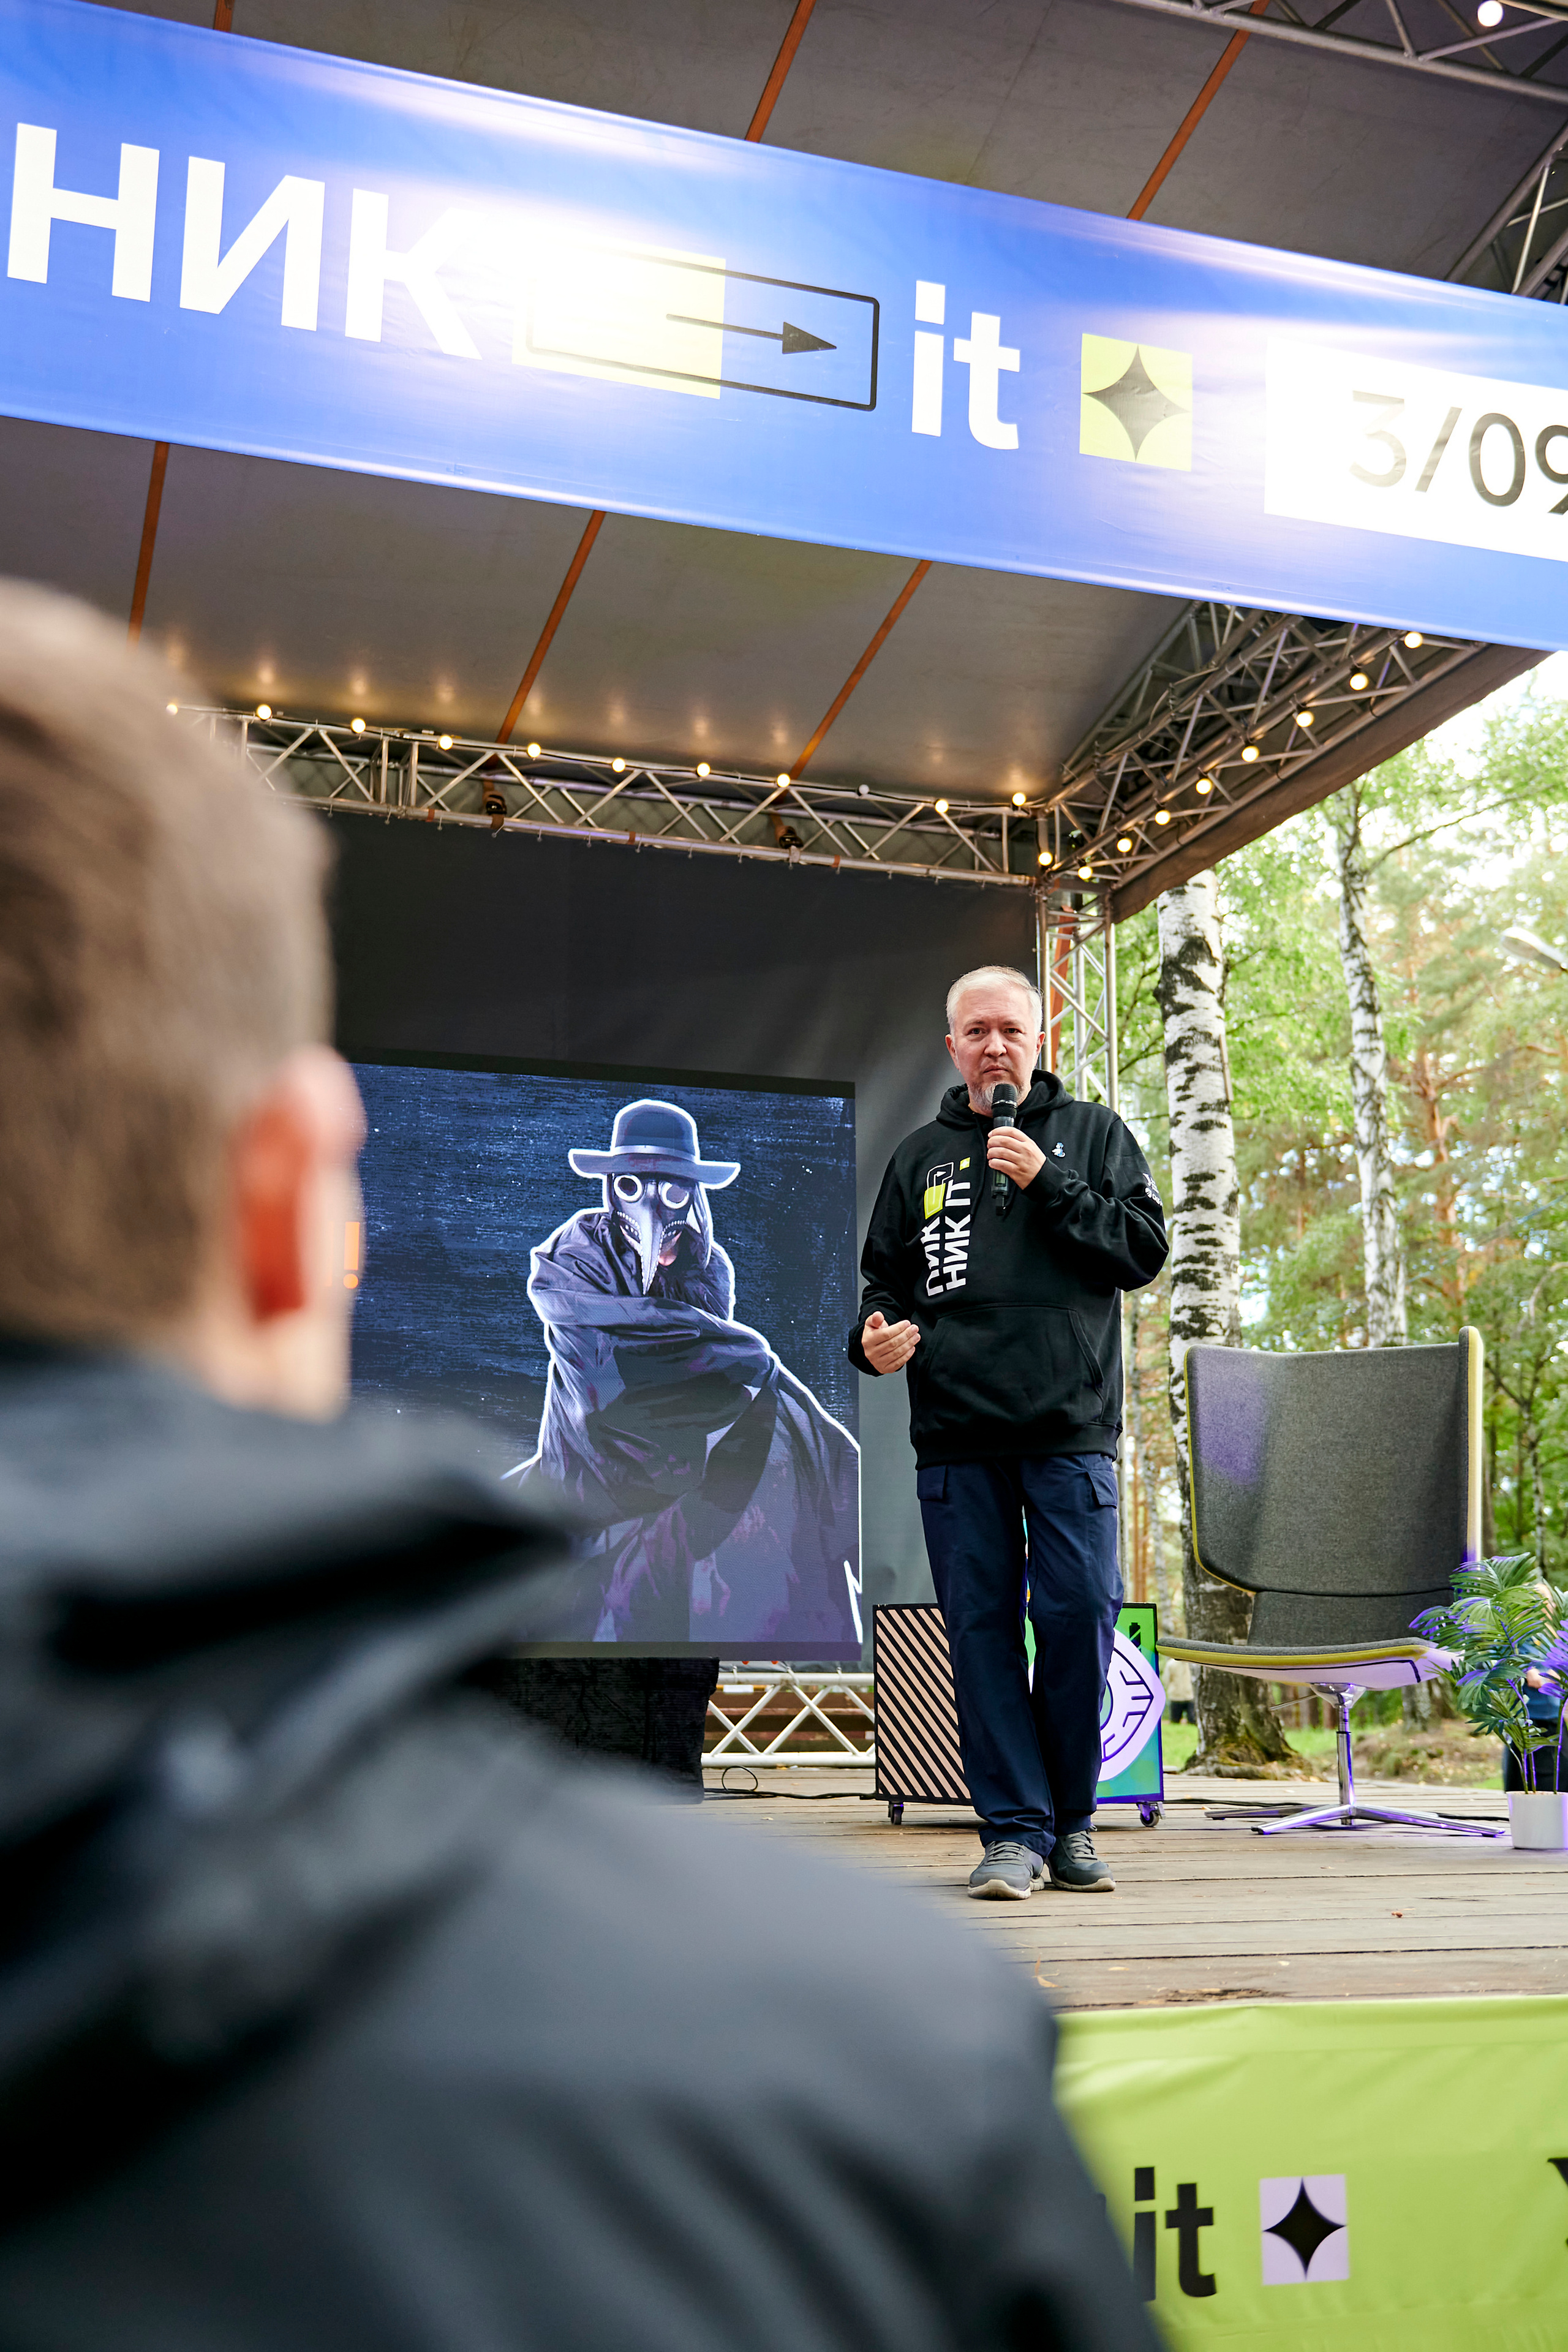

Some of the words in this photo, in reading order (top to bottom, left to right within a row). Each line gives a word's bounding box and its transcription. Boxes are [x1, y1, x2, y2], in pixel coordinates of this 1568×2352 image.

[7, 123, 488, 360] НИК
[912, 281, 1020, 450] it
[945, 1179, 971, 1207] IT
[943, 1213, 971, 1290] НИК
[1134, 2166, 1217, 2302] it
